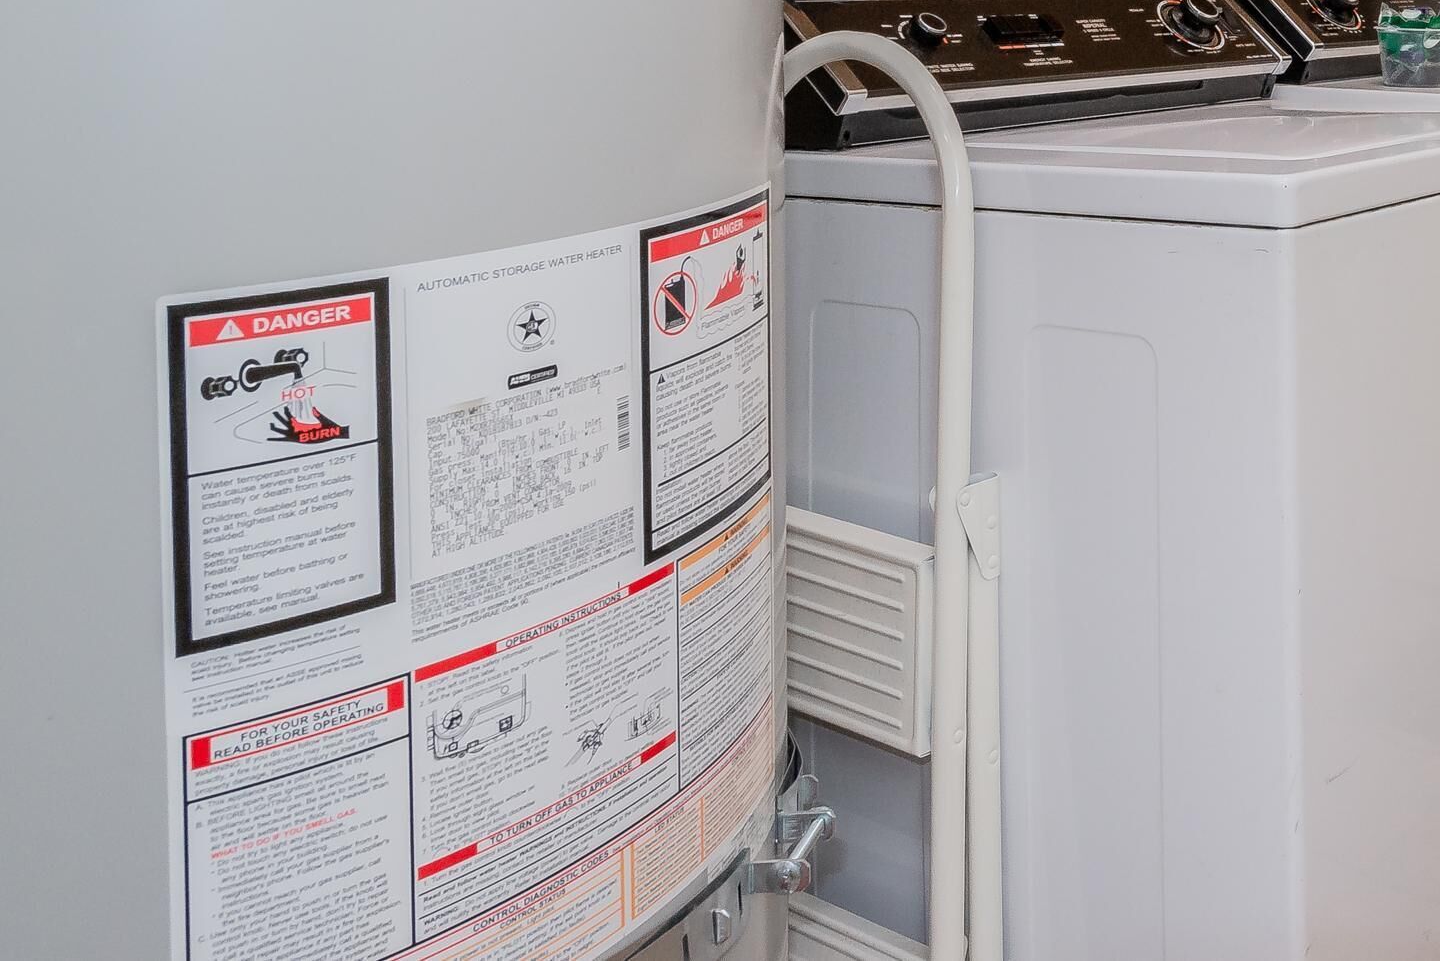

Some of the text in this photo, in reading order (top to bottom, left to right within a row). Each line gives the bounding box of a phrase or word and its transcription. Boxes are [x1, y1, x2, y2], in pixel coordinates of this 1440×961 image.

[712, 218, 744, 240] DANGER
[417, 244, 624, 292] AUTOMATIC STORAGE WATER HEATER
[252, 304, 352, 334] DANGER
[282, 386, 316, 401] HOT
[300, 427, 340, 442] BURN
[200, 478, 233, 490] Water
[237, 466, 299, 485] temperature
[302, 461, 324, 472] over
[202, 470, 325, 501] can cause severe burns
[202, 496, 246, 511] instantly
[250, 492, 260, 501] or
[263, 484, 293, 499] death
[296, 480, 318, 493] from
[254, 500, 297, 516] disabled
[300, 494, 319, 506] and
[322, 488, 354, 502] elderly
[202, 502, 338, 536] are at highest risk of being
[203, 520, 356, 561] See instruction manual before
[203, 531, 348, 569] setting temperature at water
[204, 553, 348, 592] Feel water before bathing or
[204, 572, 365, 617] Temperature limiting valves are
[259, 604, 278, 613] see
[504, 592, 622, 648] OPERATING INSTRUCTIONS
[214, 702, 384, 759] READ BEFORE OPERATING
[240, 700, 361, 742] FOR YOUR SAFETY
[490, 762, 632, 844] TO TURN OFF GAS TO APPLIANCE
[242, 842, 254, 851] TO
[284, 826, 304, 837] YOU
[306, 816, 335, 830] SMELL
[472, 851, 608, 933] CONTROL DIAGNOSTIC CODES
[500, 888, 566, 930] CONTROL STATUS
